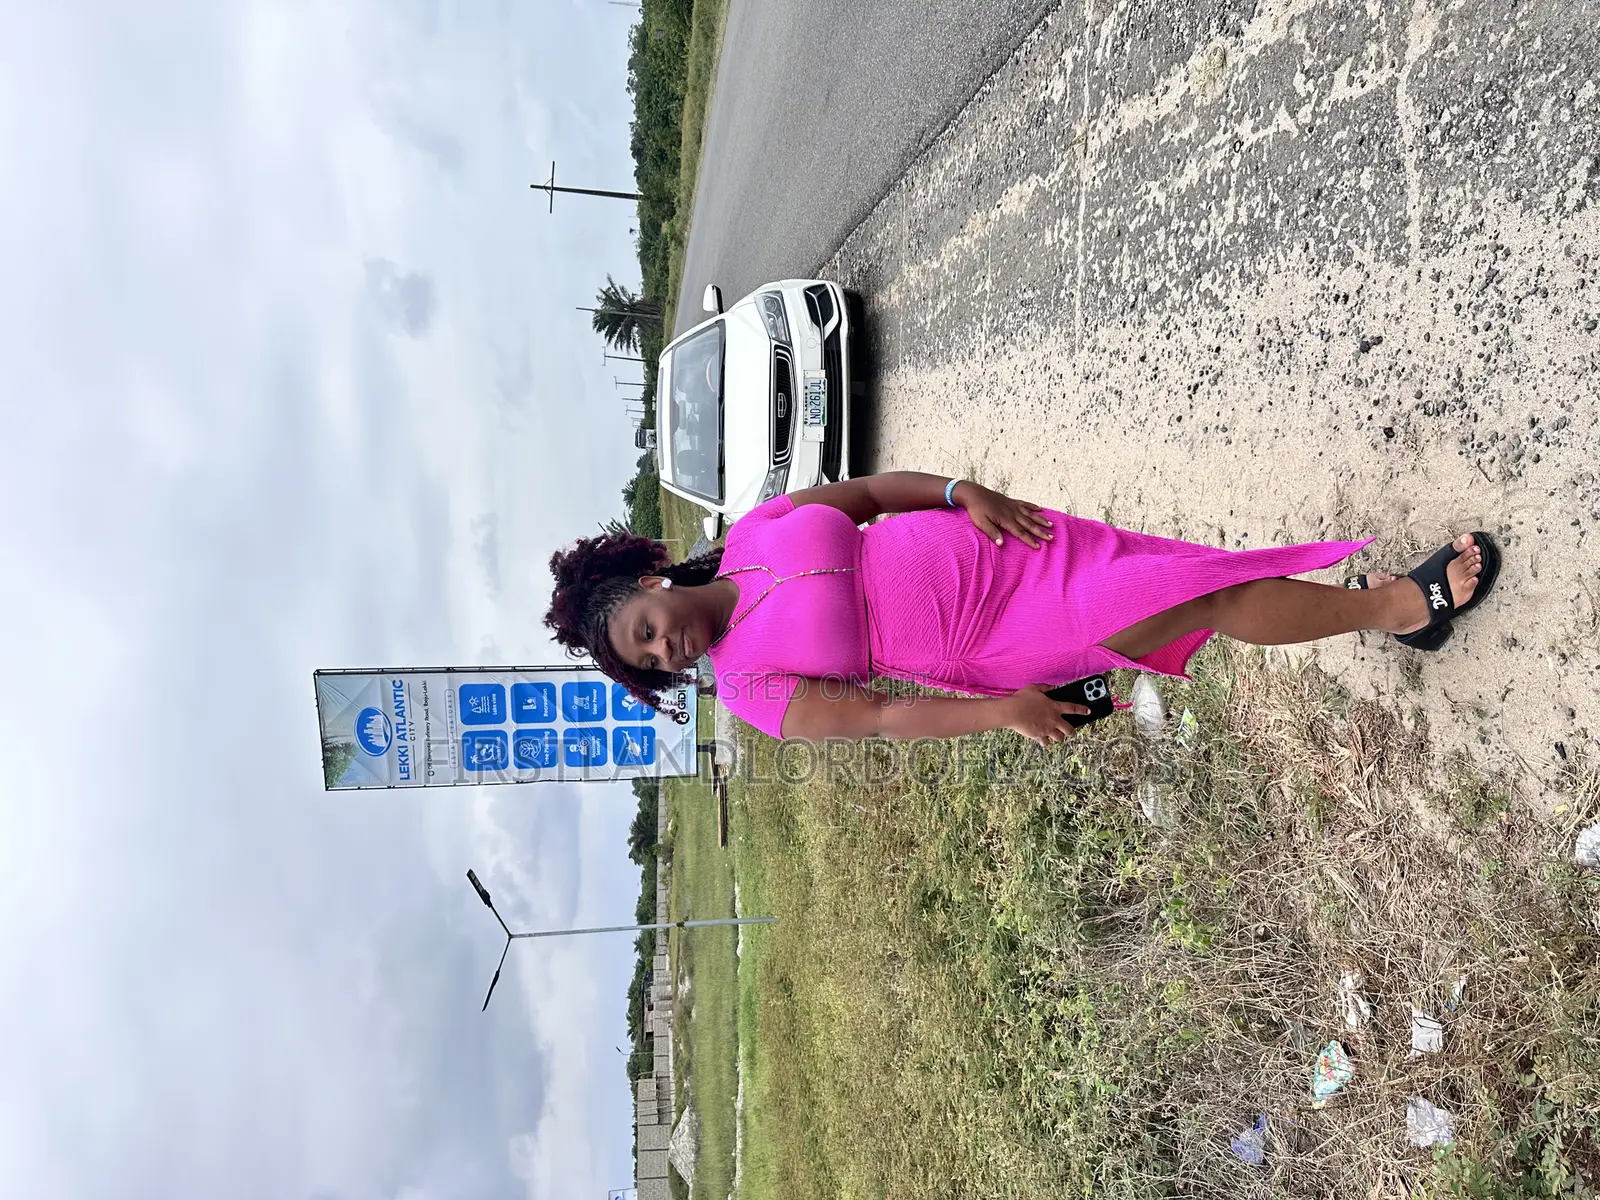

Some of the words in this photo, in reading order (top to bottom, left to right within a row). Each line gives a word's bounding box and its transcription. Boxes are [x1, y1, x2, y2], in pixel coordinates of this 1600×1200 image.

[392, 680, 408, 742] ATLANTIC
[678, 690, 686, 710] GIDI
[398, 745, 410, 780] LEKKI
